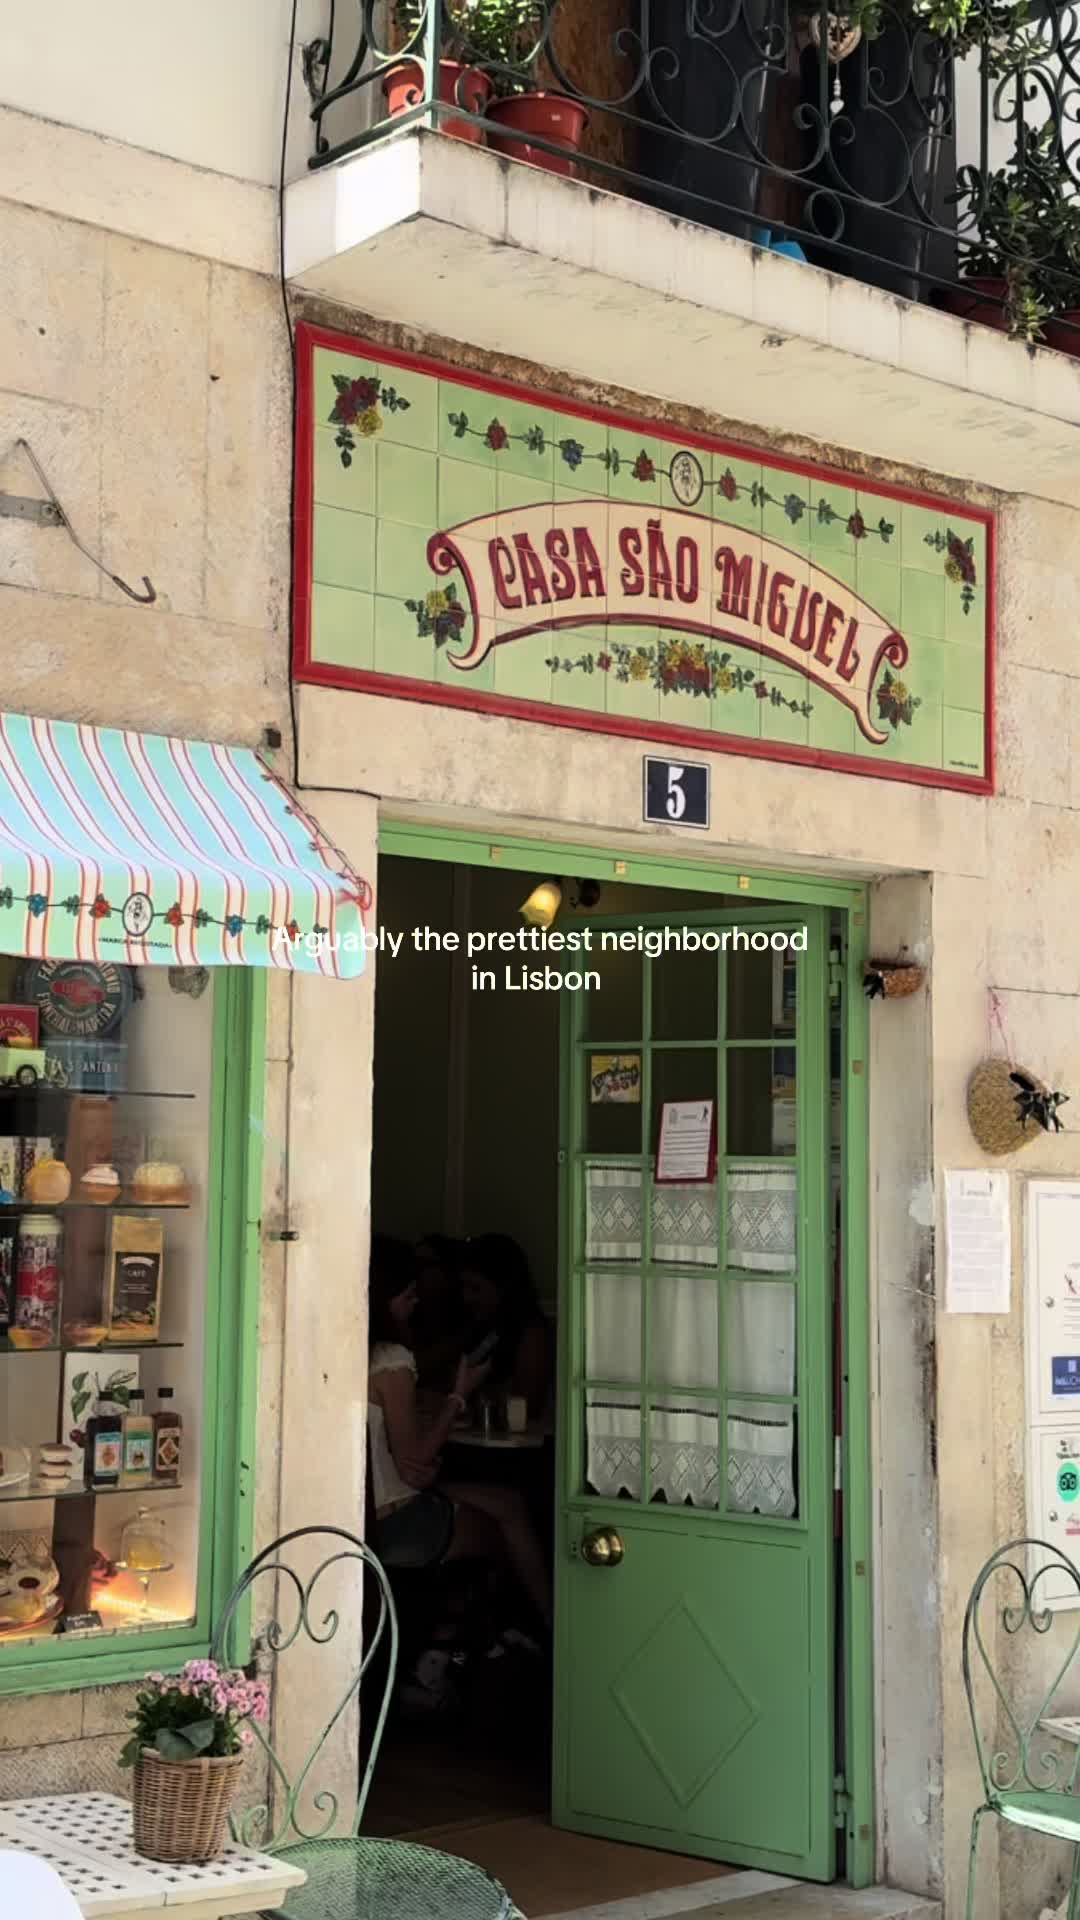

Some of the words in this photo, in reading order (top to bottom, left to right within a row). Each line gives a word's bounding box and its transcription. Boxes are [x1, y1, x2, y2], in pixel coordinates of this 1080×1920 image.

[488, 526, 606, 609] CASA
[618, 519, 699, 604] SÃO
[714, 545, 860, 684] MIGUEL
[666, 767, 685, 820] 5
